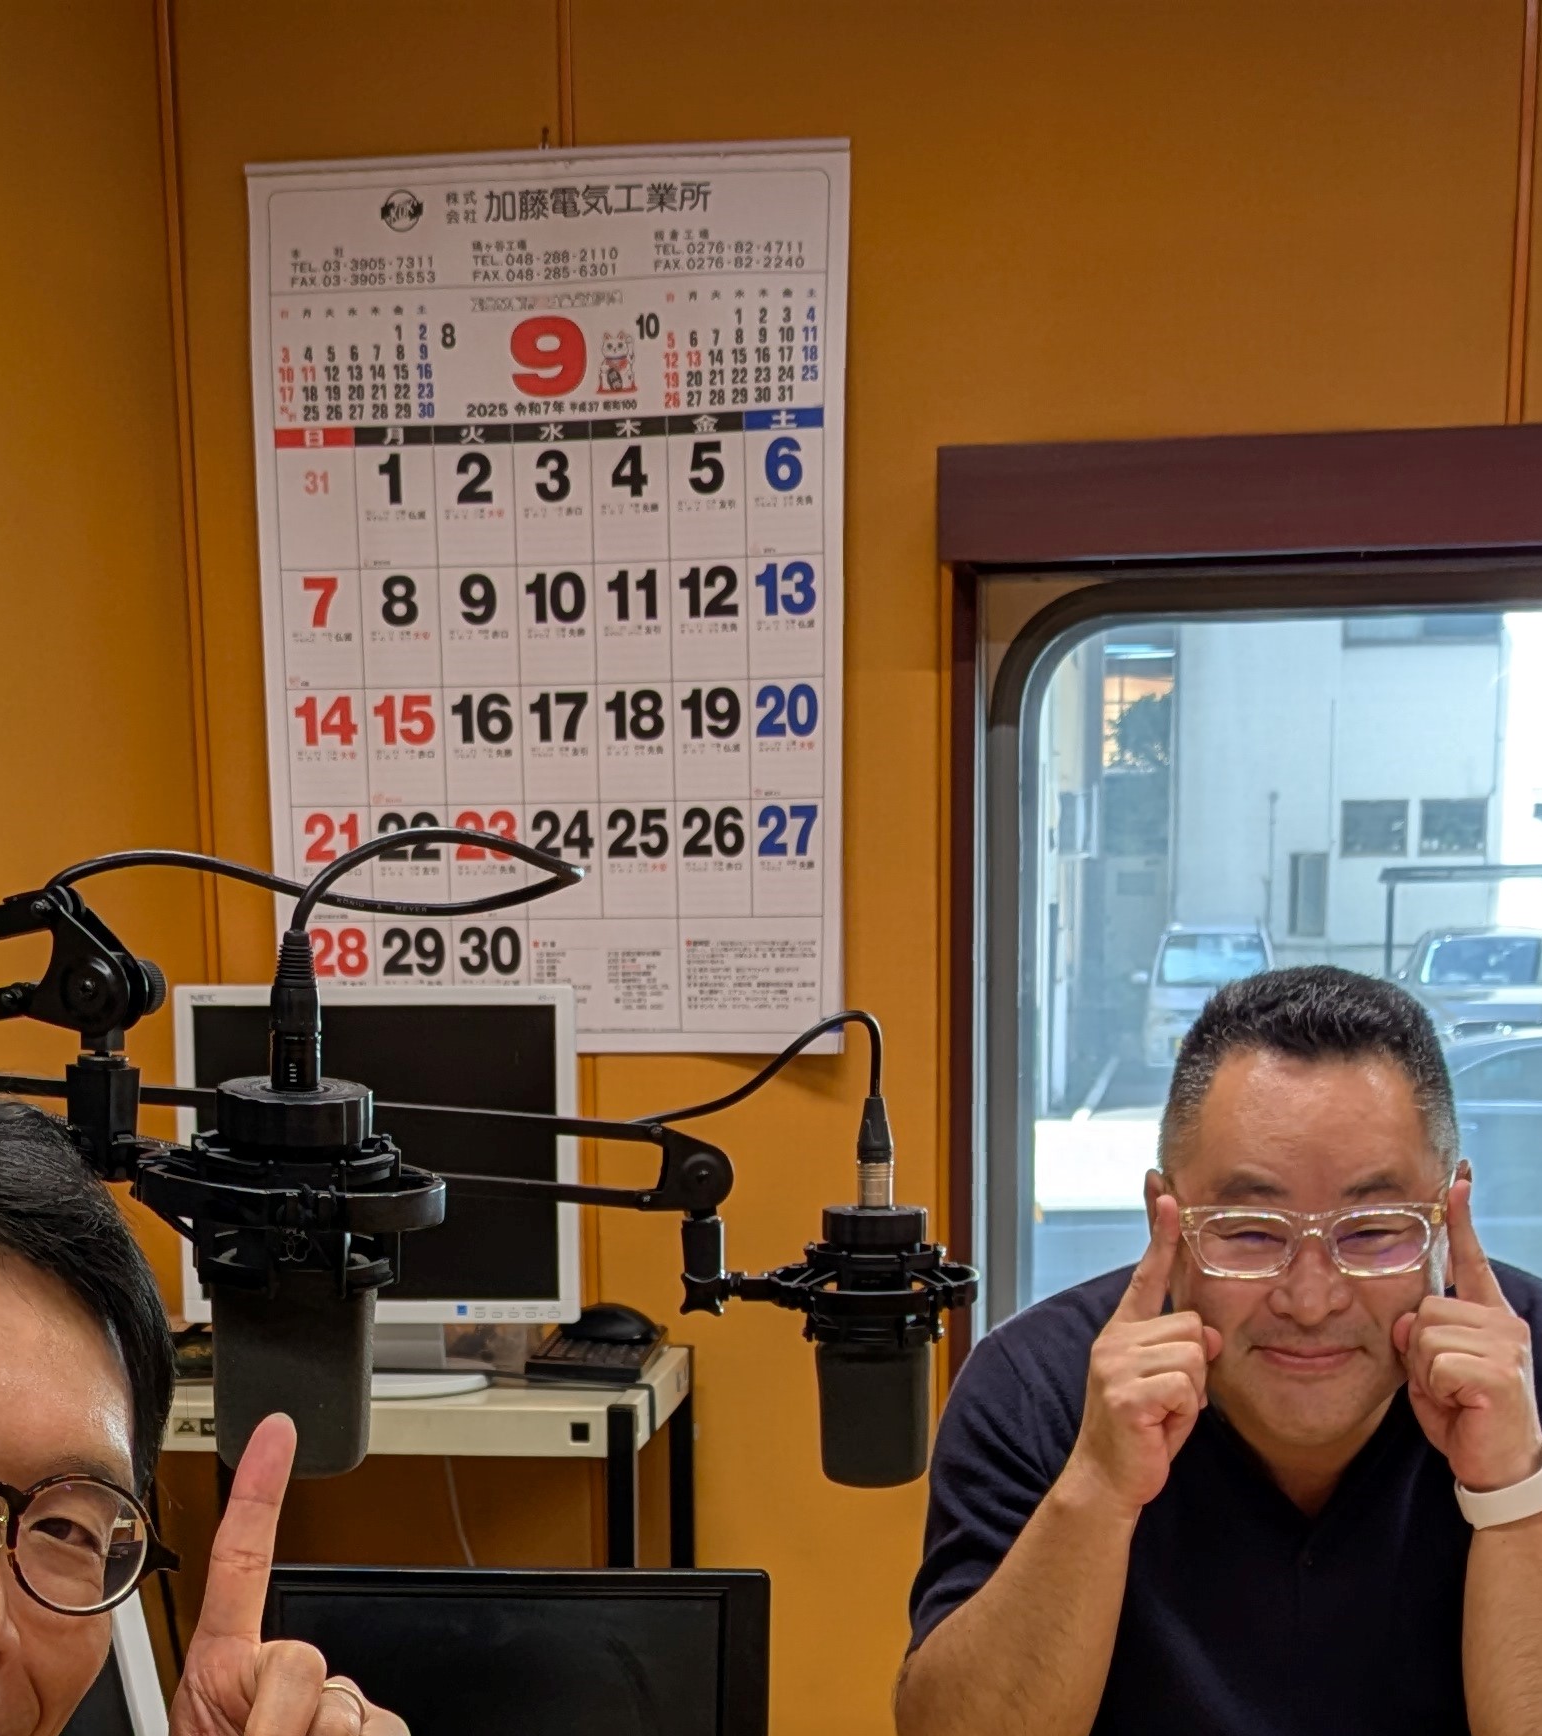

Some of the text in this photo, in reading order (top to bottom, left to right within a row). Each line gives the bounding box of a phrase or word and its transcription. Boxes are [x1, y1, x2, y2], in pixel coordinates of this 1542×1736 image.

[484, 181, 712, 223] 加藤電気工業所
[635, 312, 659, 339] 10
[735, 306, 815, 325] 1 2 3 4
[395, 324, 427, 341] 1 2
[441, 323, 456, 349] 8
[667, 326, 817, 349] 5 6 7 8 9 10 11
[282, 344, 428, 363] 3 4 5 6 7 8 9
[511, 315, 587, 398] 9
[664, 345, 818, 369] 12 13 14 15 16 17 18
[279, 364, 433, 383] 10 11 12 13 14 15 16
[664, 365, 818, 388] 19 20 21 22 23 24 25
[280, 383, 434, 402] 17 18 19 20 21 22 23
[665, 385, 793, 409] 26 27 28 29 30 31
[303, 406, 319, 421] 25
[327, 405, 342, 421] 26
[349, 405, 364, 420] 27
[372, 404, 388, 420] 28
[395, 403, 411, 419] 29
[418, 403, 435, 419] 30
[466, 403, 508, 418] 2025
[514, 401, 565, 416] 令和7年
[305, 410, 798, 447] 日 月 火 水 木 金 土
[304, 436, 803, 505] 31 1 2 3 4 5 6
[303, 561, 816, 628] 7 8 9 10 11 12 13
[294, 683, 818, 747] 14 15 16 17 18 19 20
[304, 804, 819, 863] 21 22 23 24 25 26 27
[309, 926, 521, 978] 28 29 30
